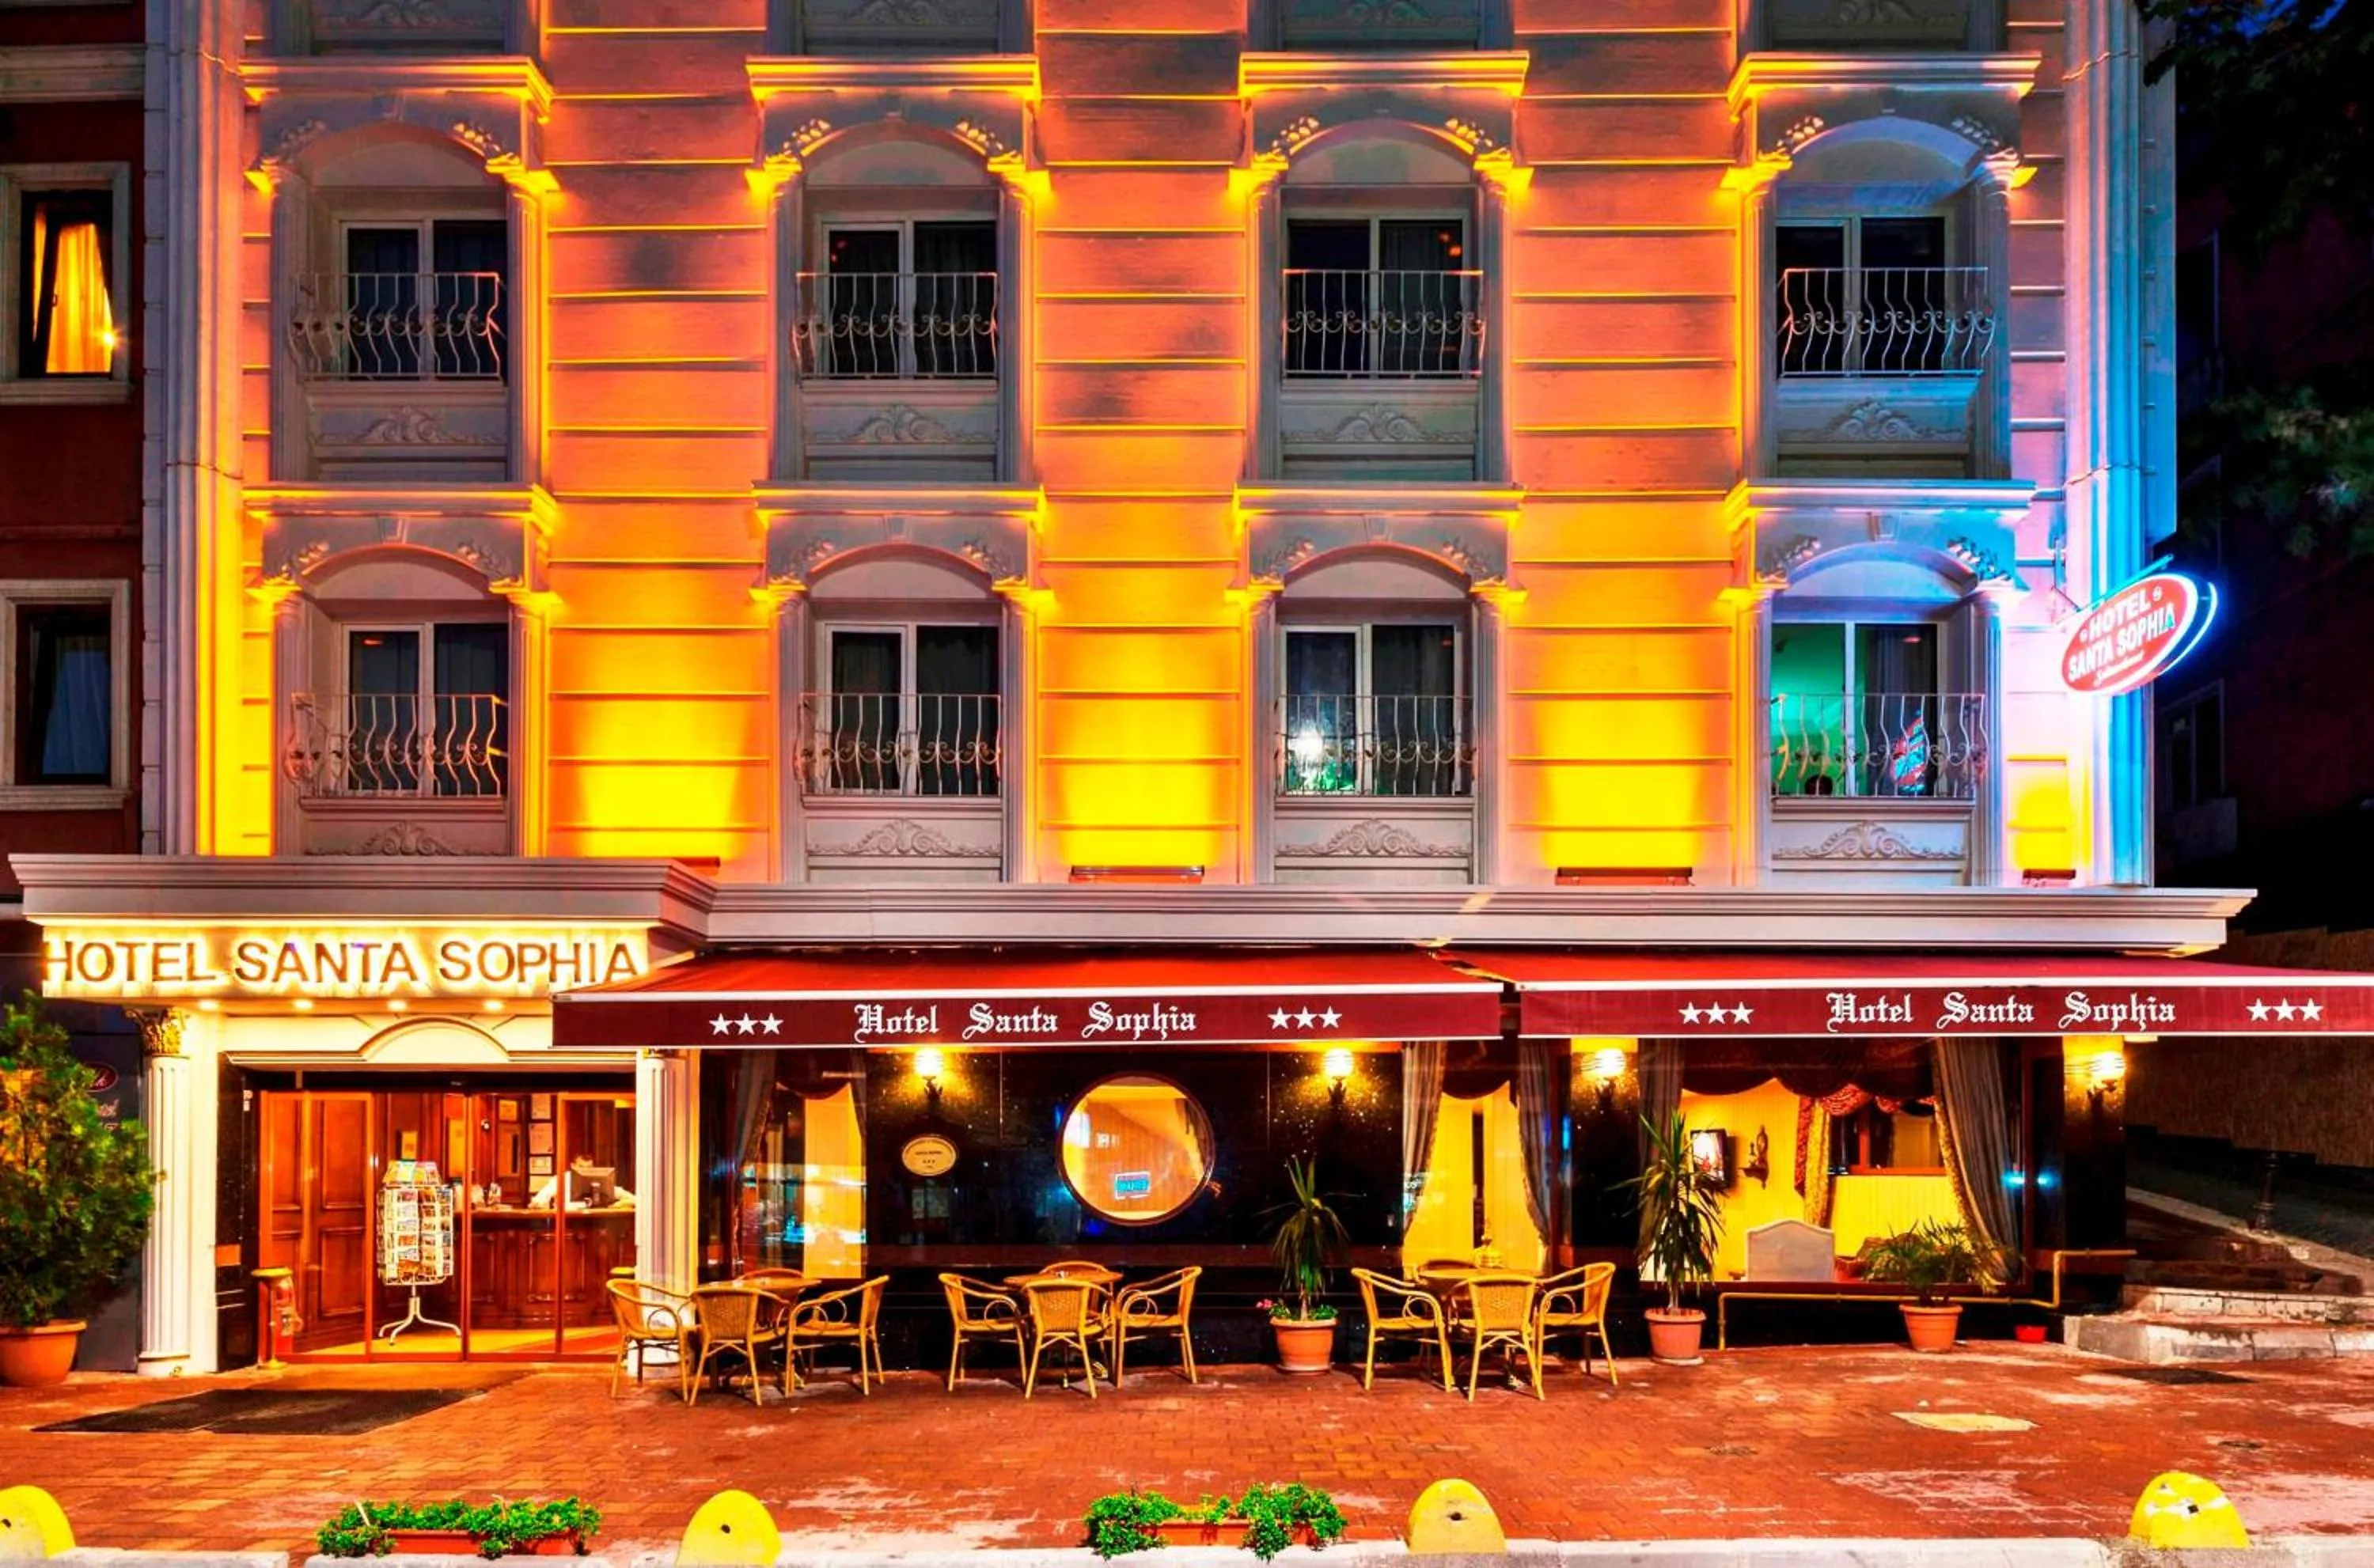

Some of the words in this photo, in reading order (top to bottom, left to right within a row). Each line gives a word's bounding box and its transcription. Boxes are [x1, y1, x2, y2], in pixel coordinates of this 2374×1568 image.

[2088, 588, 2152, 642] HOTEL
[2068, 636, 2114, 683] SANTA
[2116, 602, 2176, 655] SOPHIA
[43, 941, 217, 982] HOTEL
[234, 941, 419, 983] SANTA
[439, 941, 638, 983] SOPHIA
[854, 1003, 940, 1043] Hotel
[961, 1002, 1059, 1040] Santa
[1081, 1000, 1196, 1041] Sophia
[1826, 991, 1914, 1033] Hotel
[1936, 990, 2035, 1029] Santa
[2057, 990, 2176, 1032] Sophia
